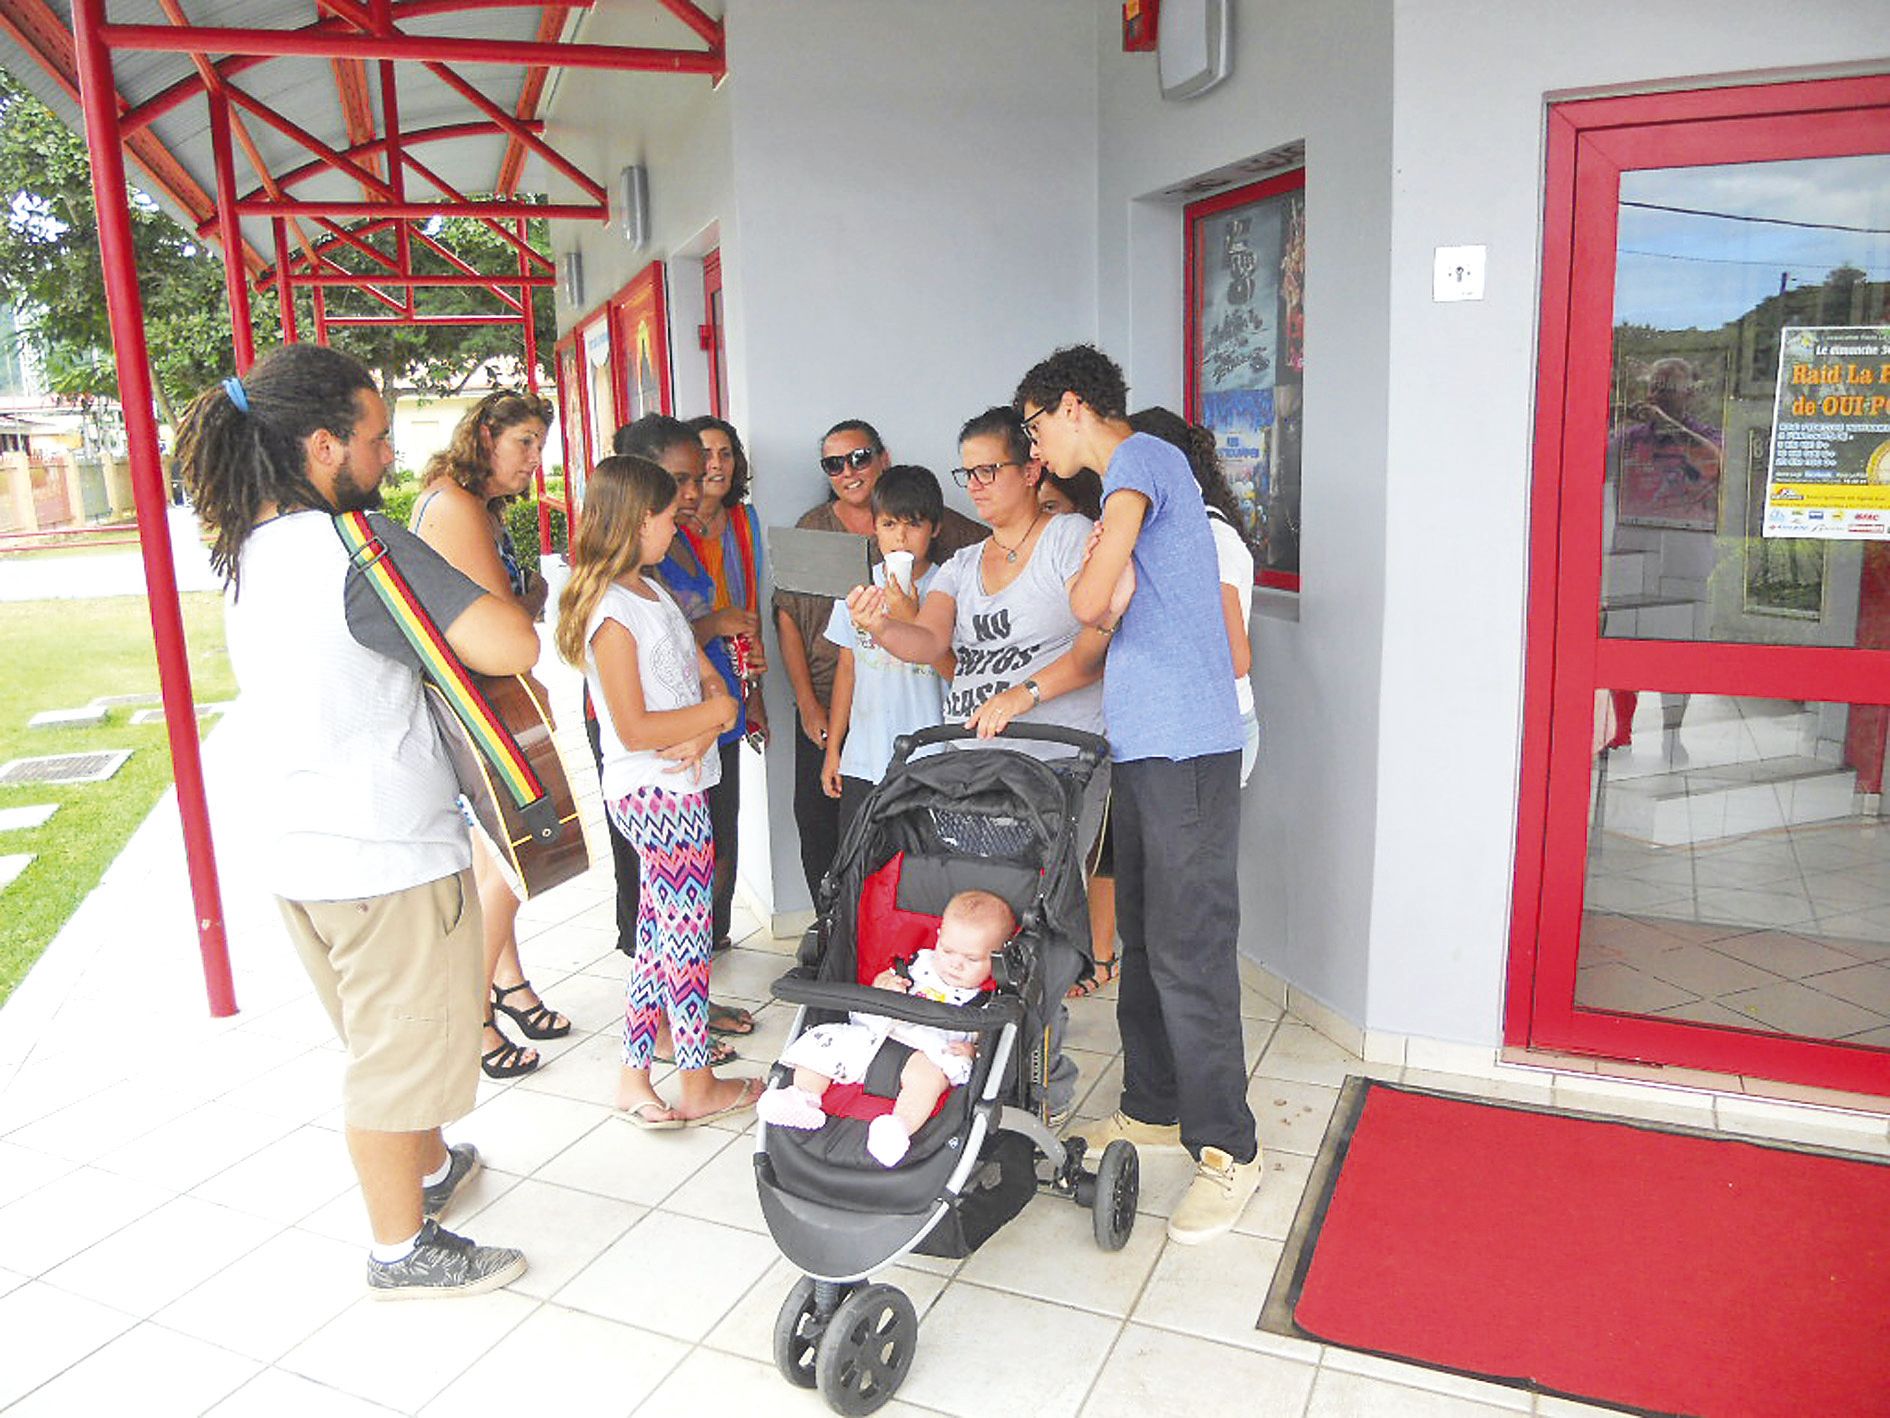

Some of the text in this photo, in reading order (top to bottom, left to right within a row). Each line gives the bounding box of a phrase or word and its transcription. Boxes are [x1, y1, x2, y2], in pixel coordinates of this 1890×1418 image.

[1815, 344, 1828, 356] Le
[1792, 363, 1841, 385] Raid
[1848, 364, 1874, 385] La
[1792, 394, 1816, 416] de
[1822, 395, 1864, 417] OUI
[972, 608, 1011, 642] NO
